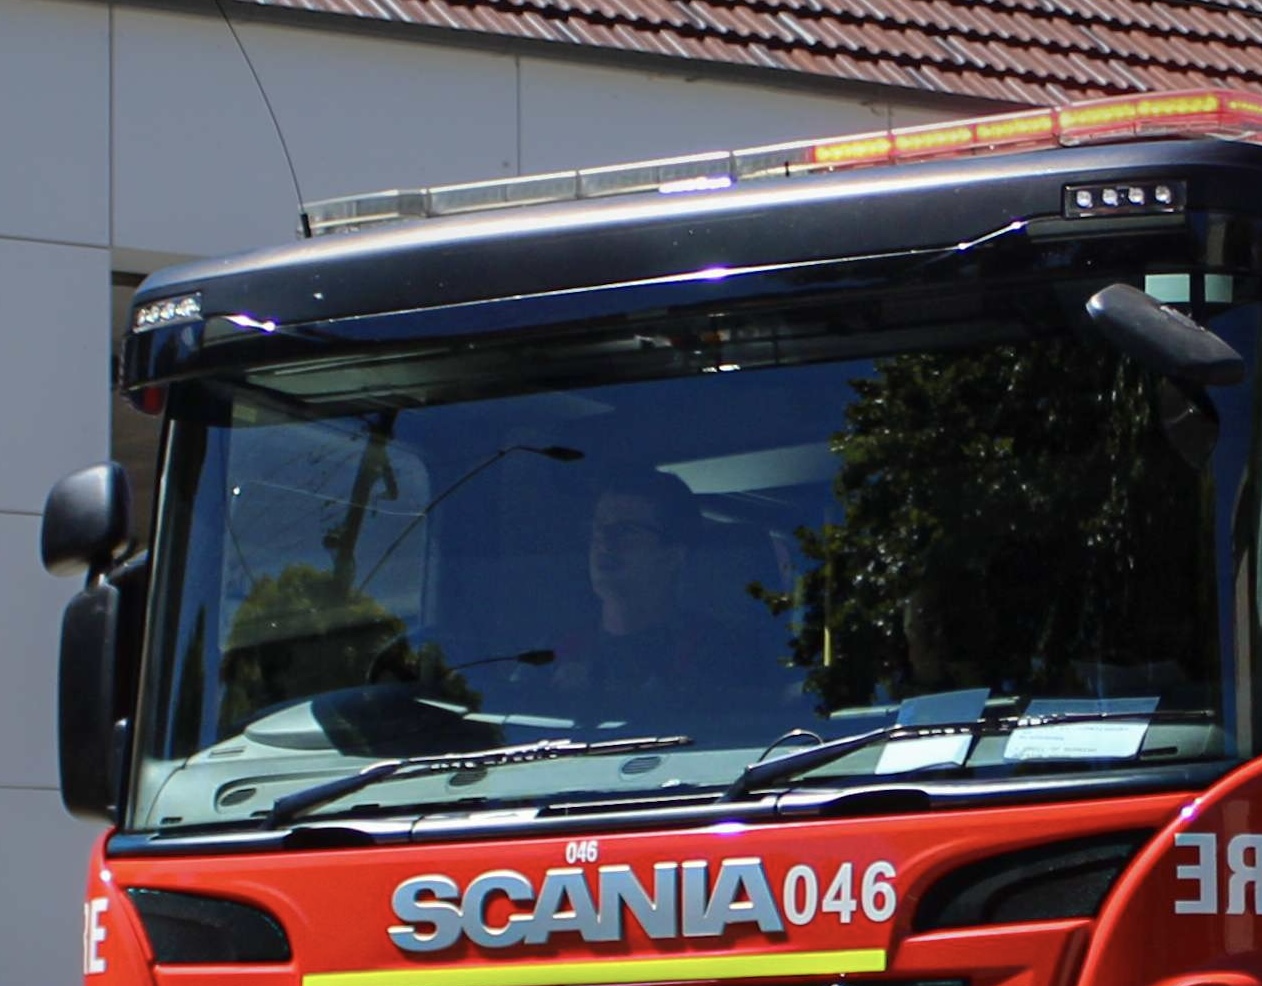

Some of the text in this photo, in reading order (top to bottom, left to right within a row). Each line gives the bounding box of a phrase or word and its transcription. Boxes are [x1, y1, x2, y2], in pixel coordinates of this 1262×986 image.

[565, 841, 598, 864] 046
[387, 857, 785, 952] SCANIA
[782, 861, 897, 925] 046
